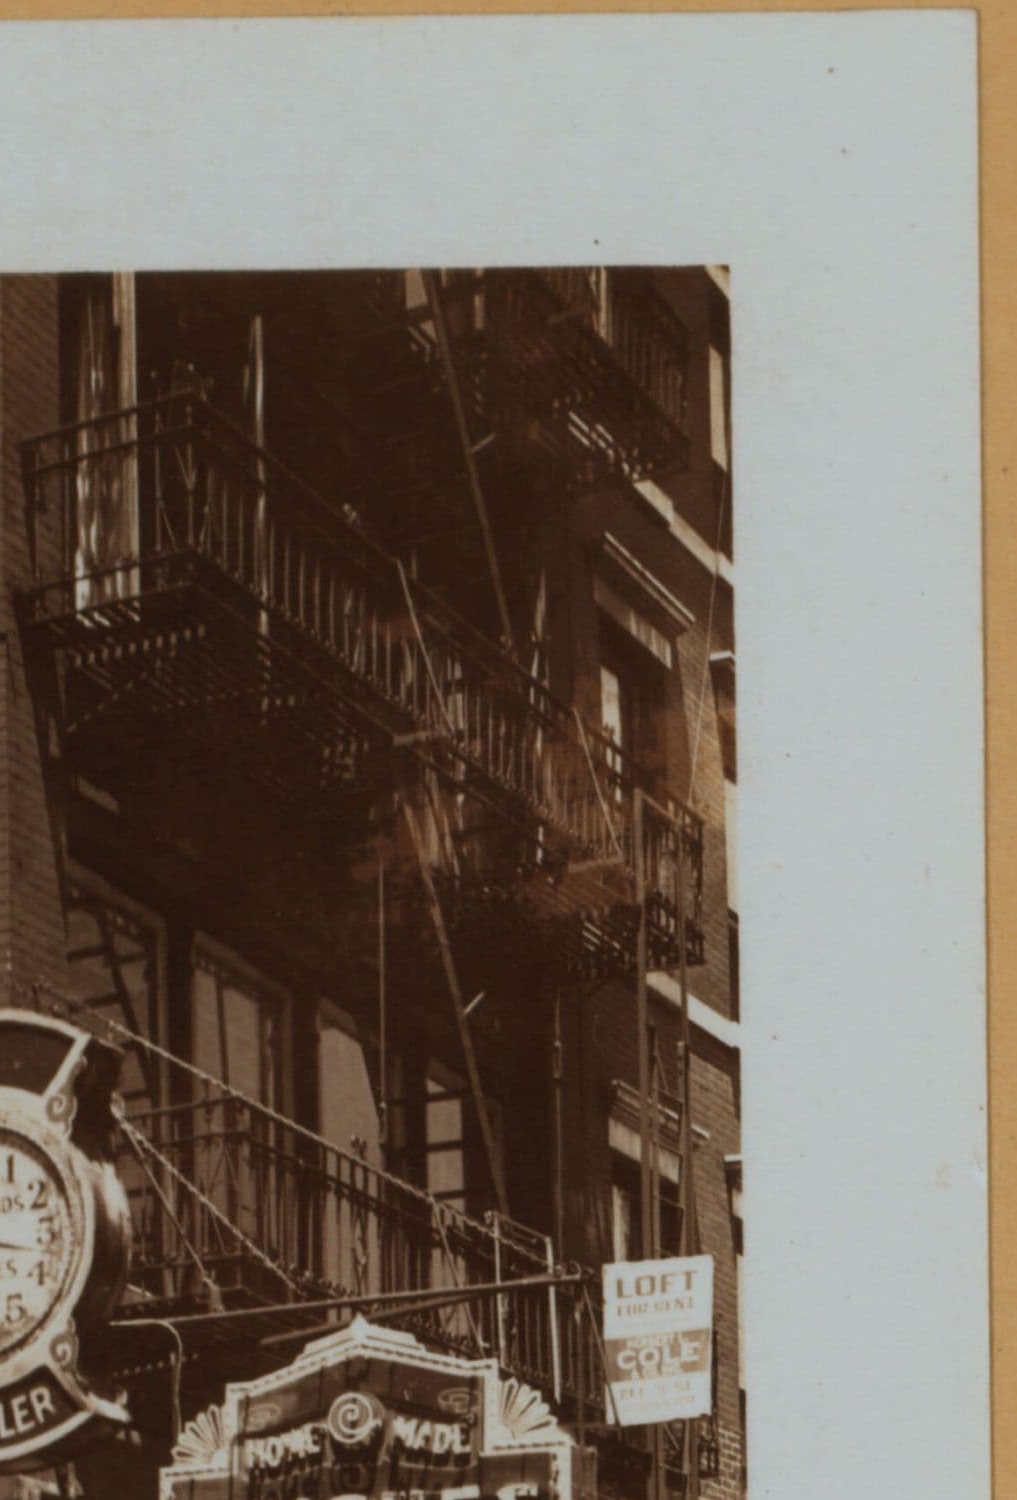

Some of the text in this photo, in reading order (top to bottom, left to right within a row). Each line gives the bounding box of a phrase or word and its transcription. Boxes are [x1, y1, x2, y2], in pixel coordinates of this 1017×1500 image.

[5, 1154, 16, 1184] 1
[28, 1180, 47, 1210] 2
[616, 1270, 698, 1298] LOFT
[5, 1293, 25, 1324] 5
[617, 1339, 701, 1371] COLE
[245, 1415, 471, 1469] HOME MADE
